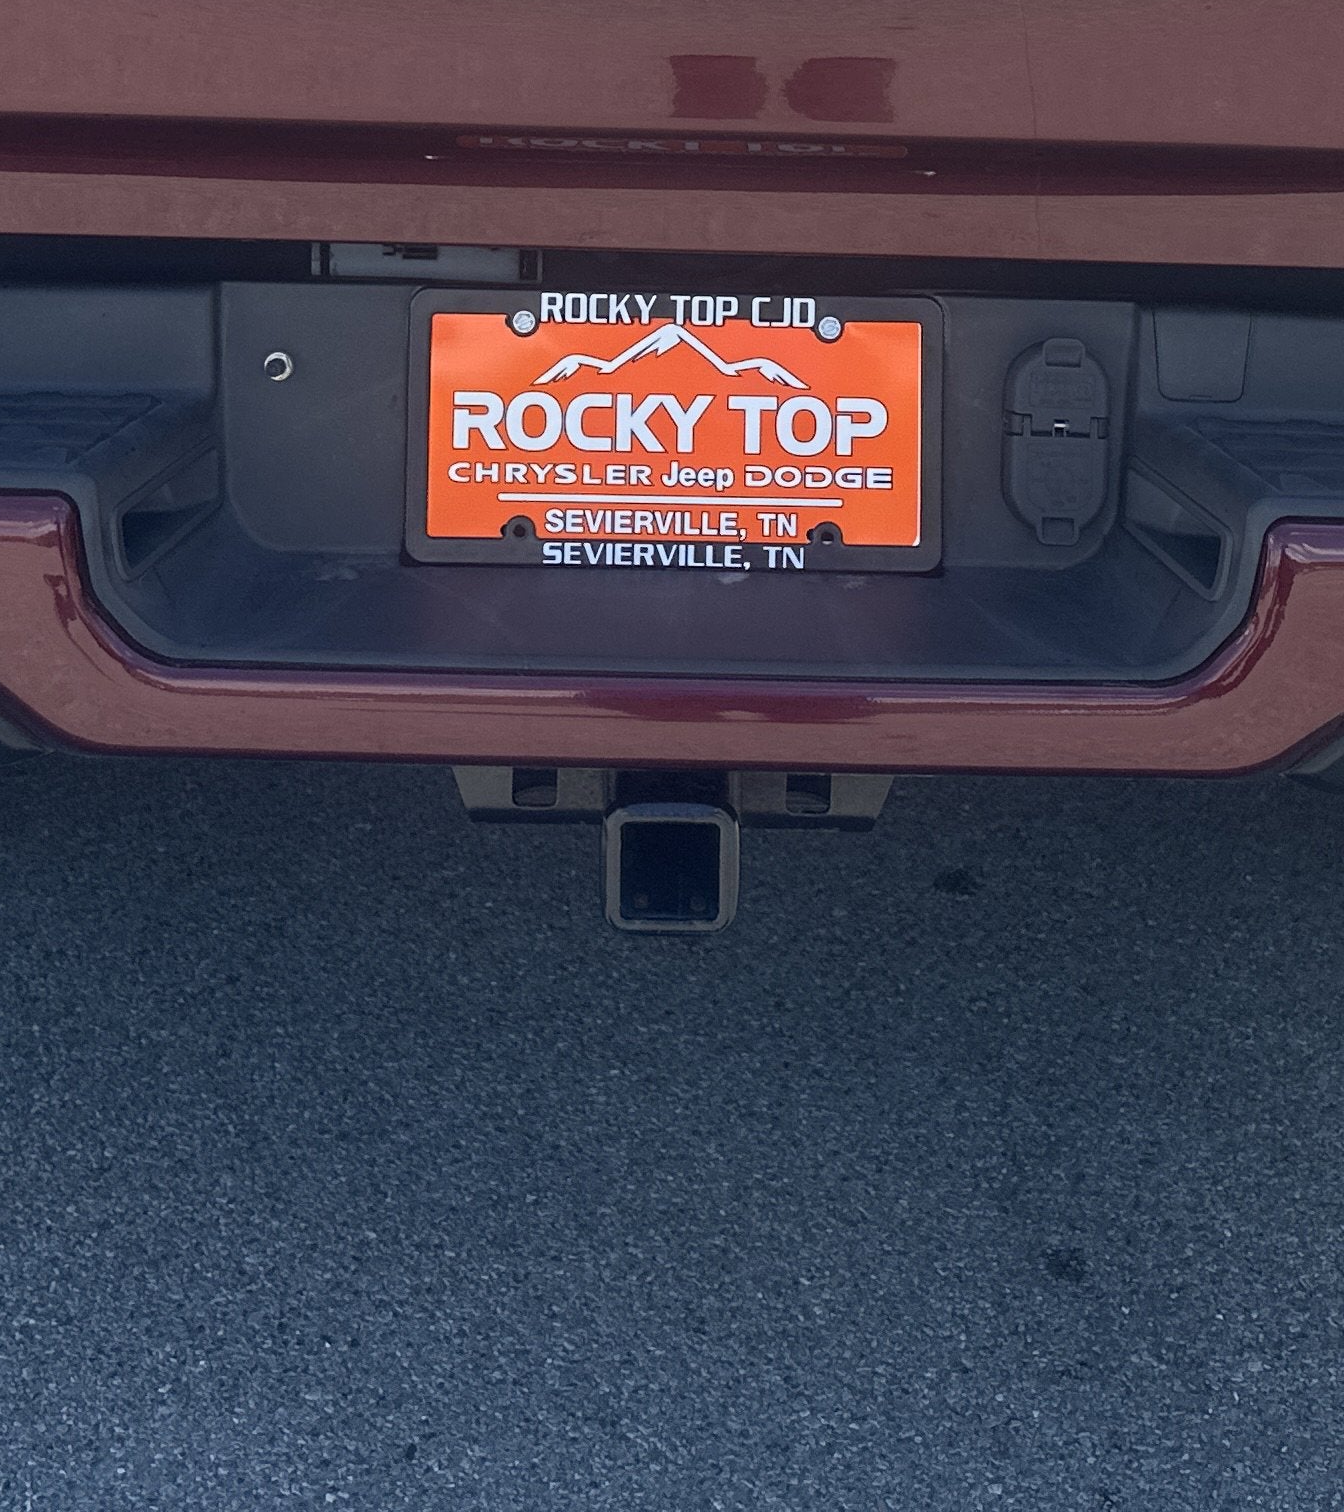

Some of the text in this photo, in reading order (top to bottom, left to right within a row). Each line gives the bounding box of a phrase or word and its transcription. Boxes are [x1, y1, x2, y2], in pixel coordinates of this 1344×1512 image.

[539, 292, 658, 324] ROCKY
[670, 295, 738, 326] TOP
[452, 391, 888, 457] ROCKY TOP
[447, 461, 893, 490] CHRYSLER Jeep DODGE
[544, 508, 798, 541] SEVIERVILLE, TN
[542, 542, 805, 571] SEVIERVILLE, TN
